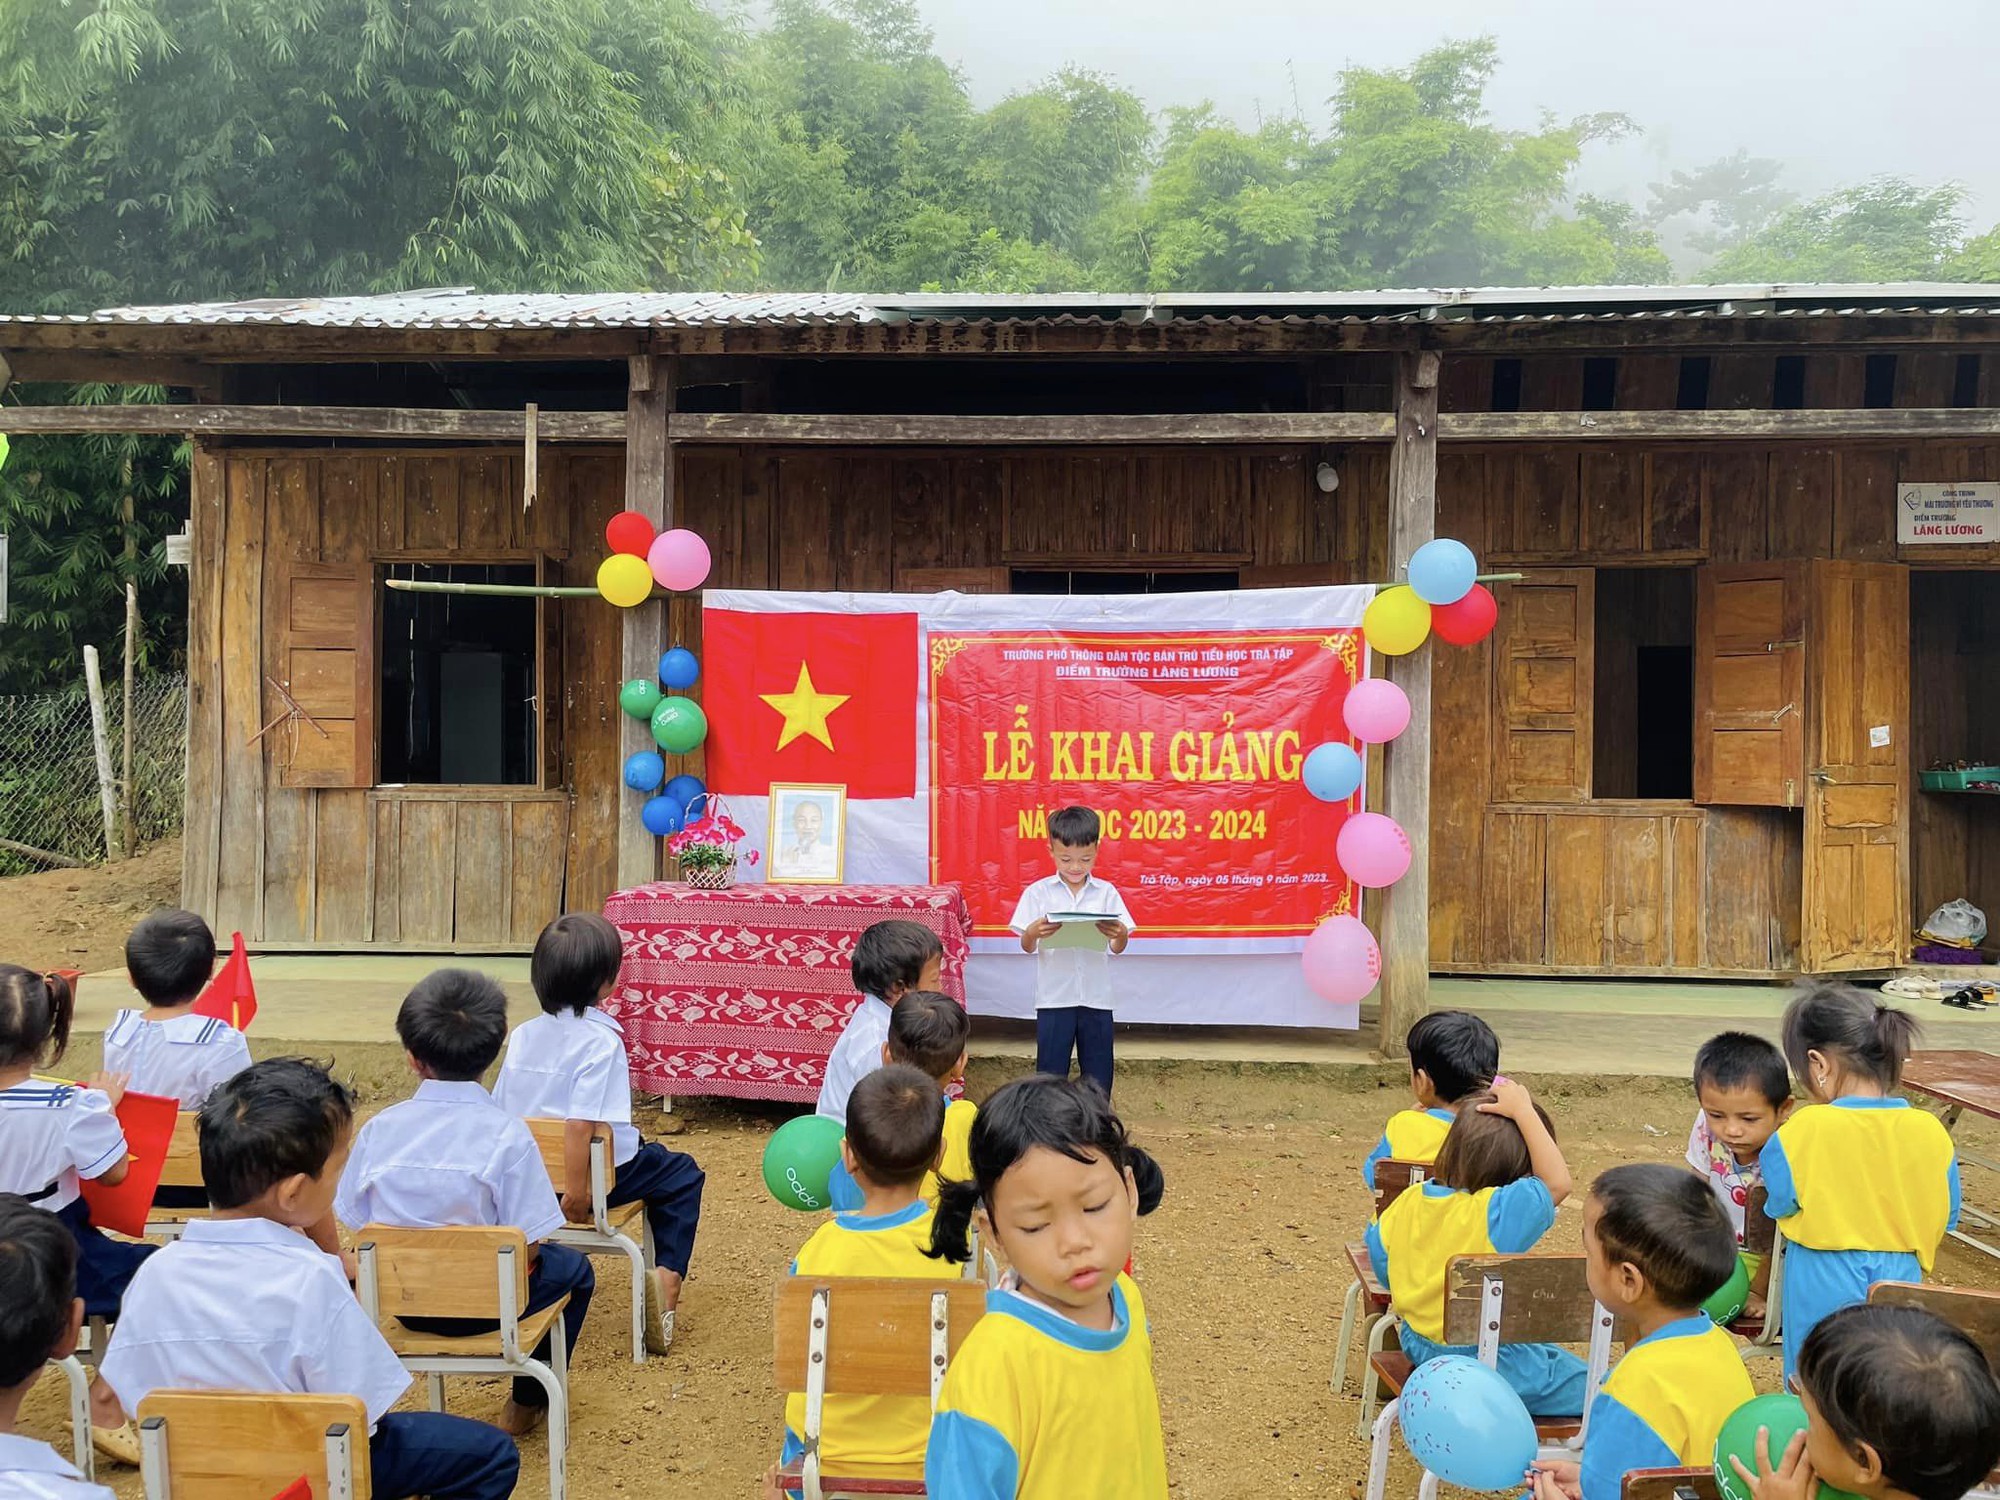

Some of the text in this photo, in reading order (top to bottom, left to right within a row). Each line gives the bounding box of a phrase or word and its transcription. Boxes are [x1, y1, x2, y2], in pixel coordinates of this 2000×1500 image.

[1945, 524, 1983, 535] LƯƠNG
[1003, 648, 1044, 660] TRƯỜNG
[1070, 649, 1104, 661] THÔNG
[1106, 650, 1128, 662] DÂN
[1130, 651, 1151, 664] TỘC
[1201, 647, 1223, 661] TIỂU
[1226, 650, 1247, 663] HỌC
[1273, 646, 1294, 661] TẬP
[1056, 663, 1239, 678] ĐIỂM TRƯỜNG LÀNG LƯƠNG
[983, 704, 1303, 781] LỄ KHAI GIẢNG
[1018, 804, 1056, 839] NĂ
[1128, 809, 1186, 840] 2023
[1193, 824, 1203, 832] -
[1208, 809, 1267, 840] 2024
[1140, 875, 1157, 884] Trà
[1159, 875, 1182, 888] Tập,
[1185, 875, 1212, 886] ngày
[1232, 874, 1263, 885] tháng
[1266, 875, 1273, 884] 9
[1275, 875, 1299, 884] năm
[1301, 873, 1329, 883] 2023.
